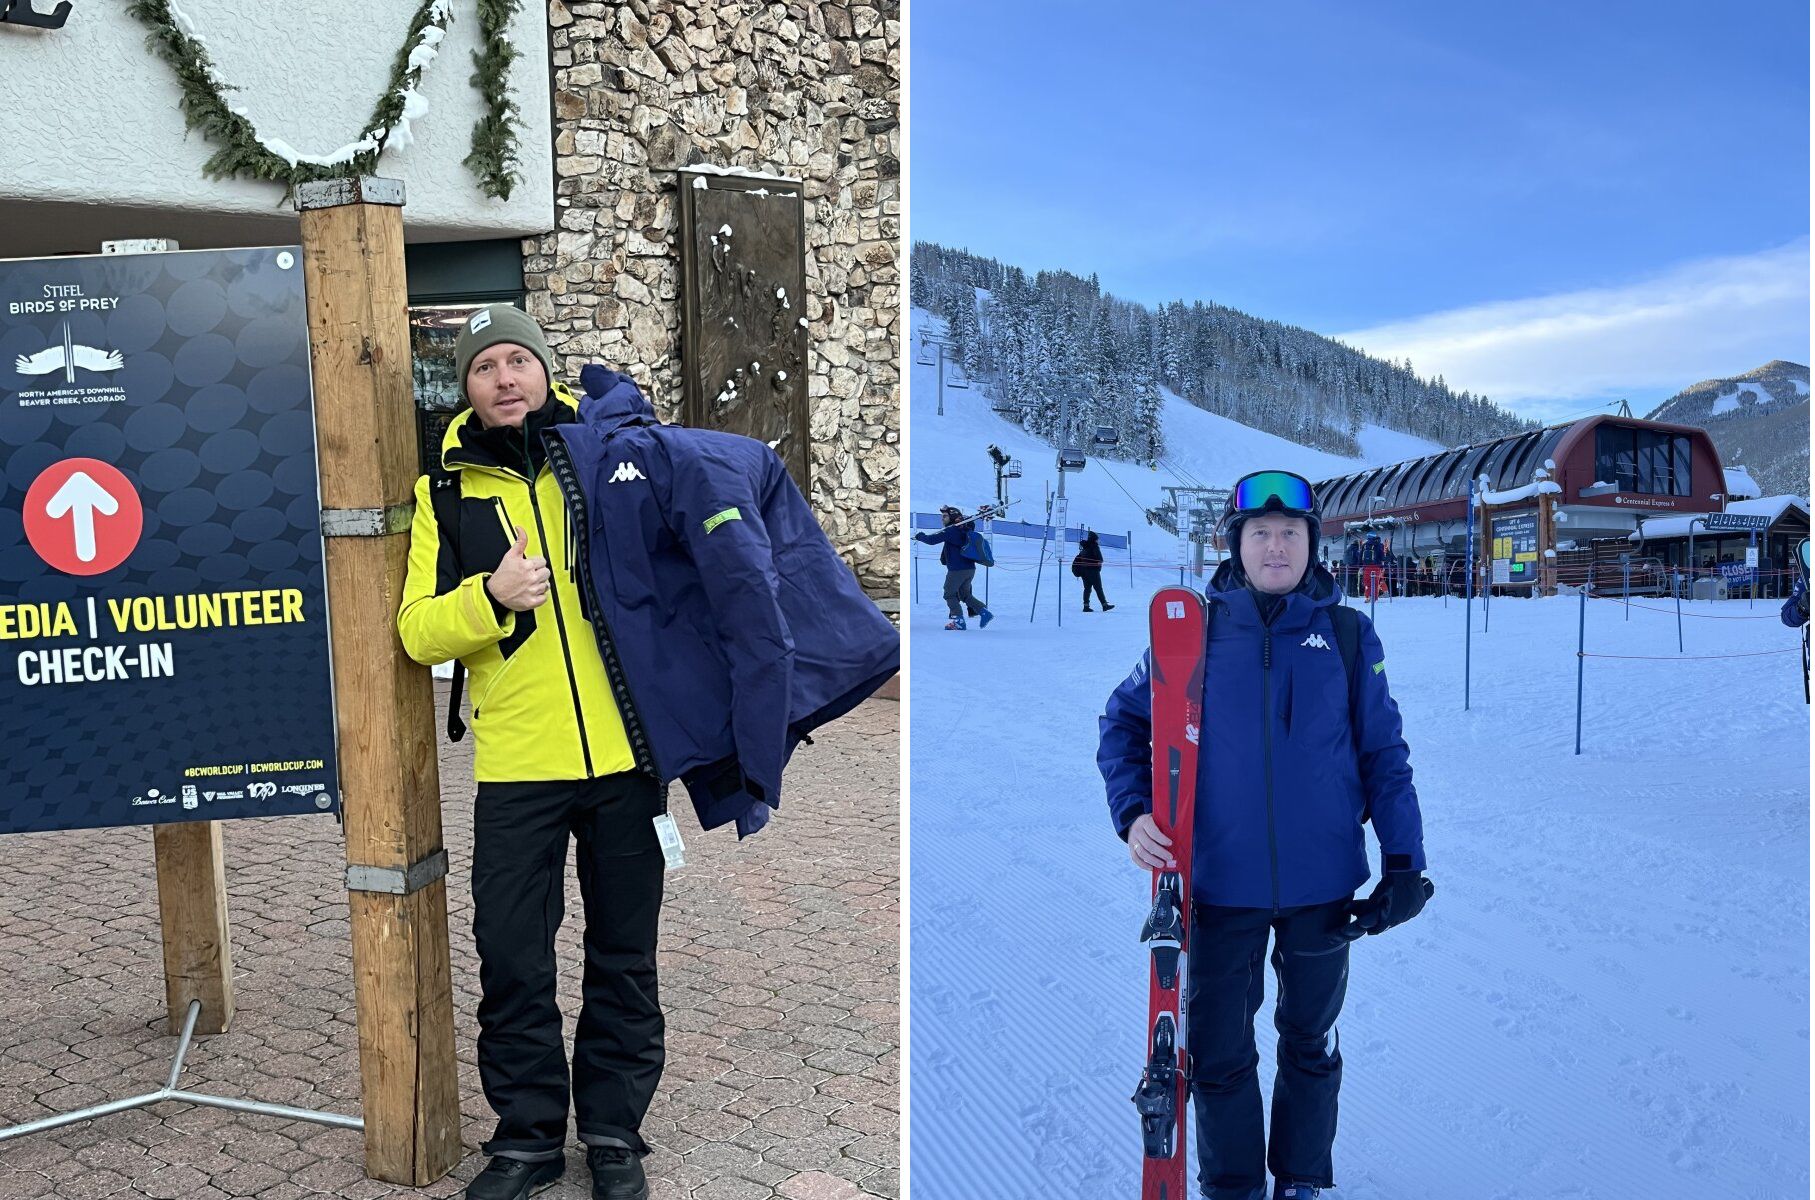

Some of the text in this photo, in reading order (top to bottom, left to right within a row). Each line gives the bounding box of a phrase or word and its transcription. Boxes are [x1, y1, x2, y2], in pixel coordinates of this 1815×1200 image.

[44, 284, 84, 298] STIFEL
[10, 297, 119, 314] BIRDS OF PREY
[1623, 497, 1650, 505] Centennial
[1652, 499, 1670, 507] Express
[1414, 511, 1420, 520] 6
[1722, 564, 1754, 577] CLOSE
[108, 588, 305, 633] VOLUNTEER
[18, 642, 174, 686] CHECK-IN
[251, 760, 323, 773] BCWORLDCUP.COM
[282, 784, 325, 793] LONGINES
